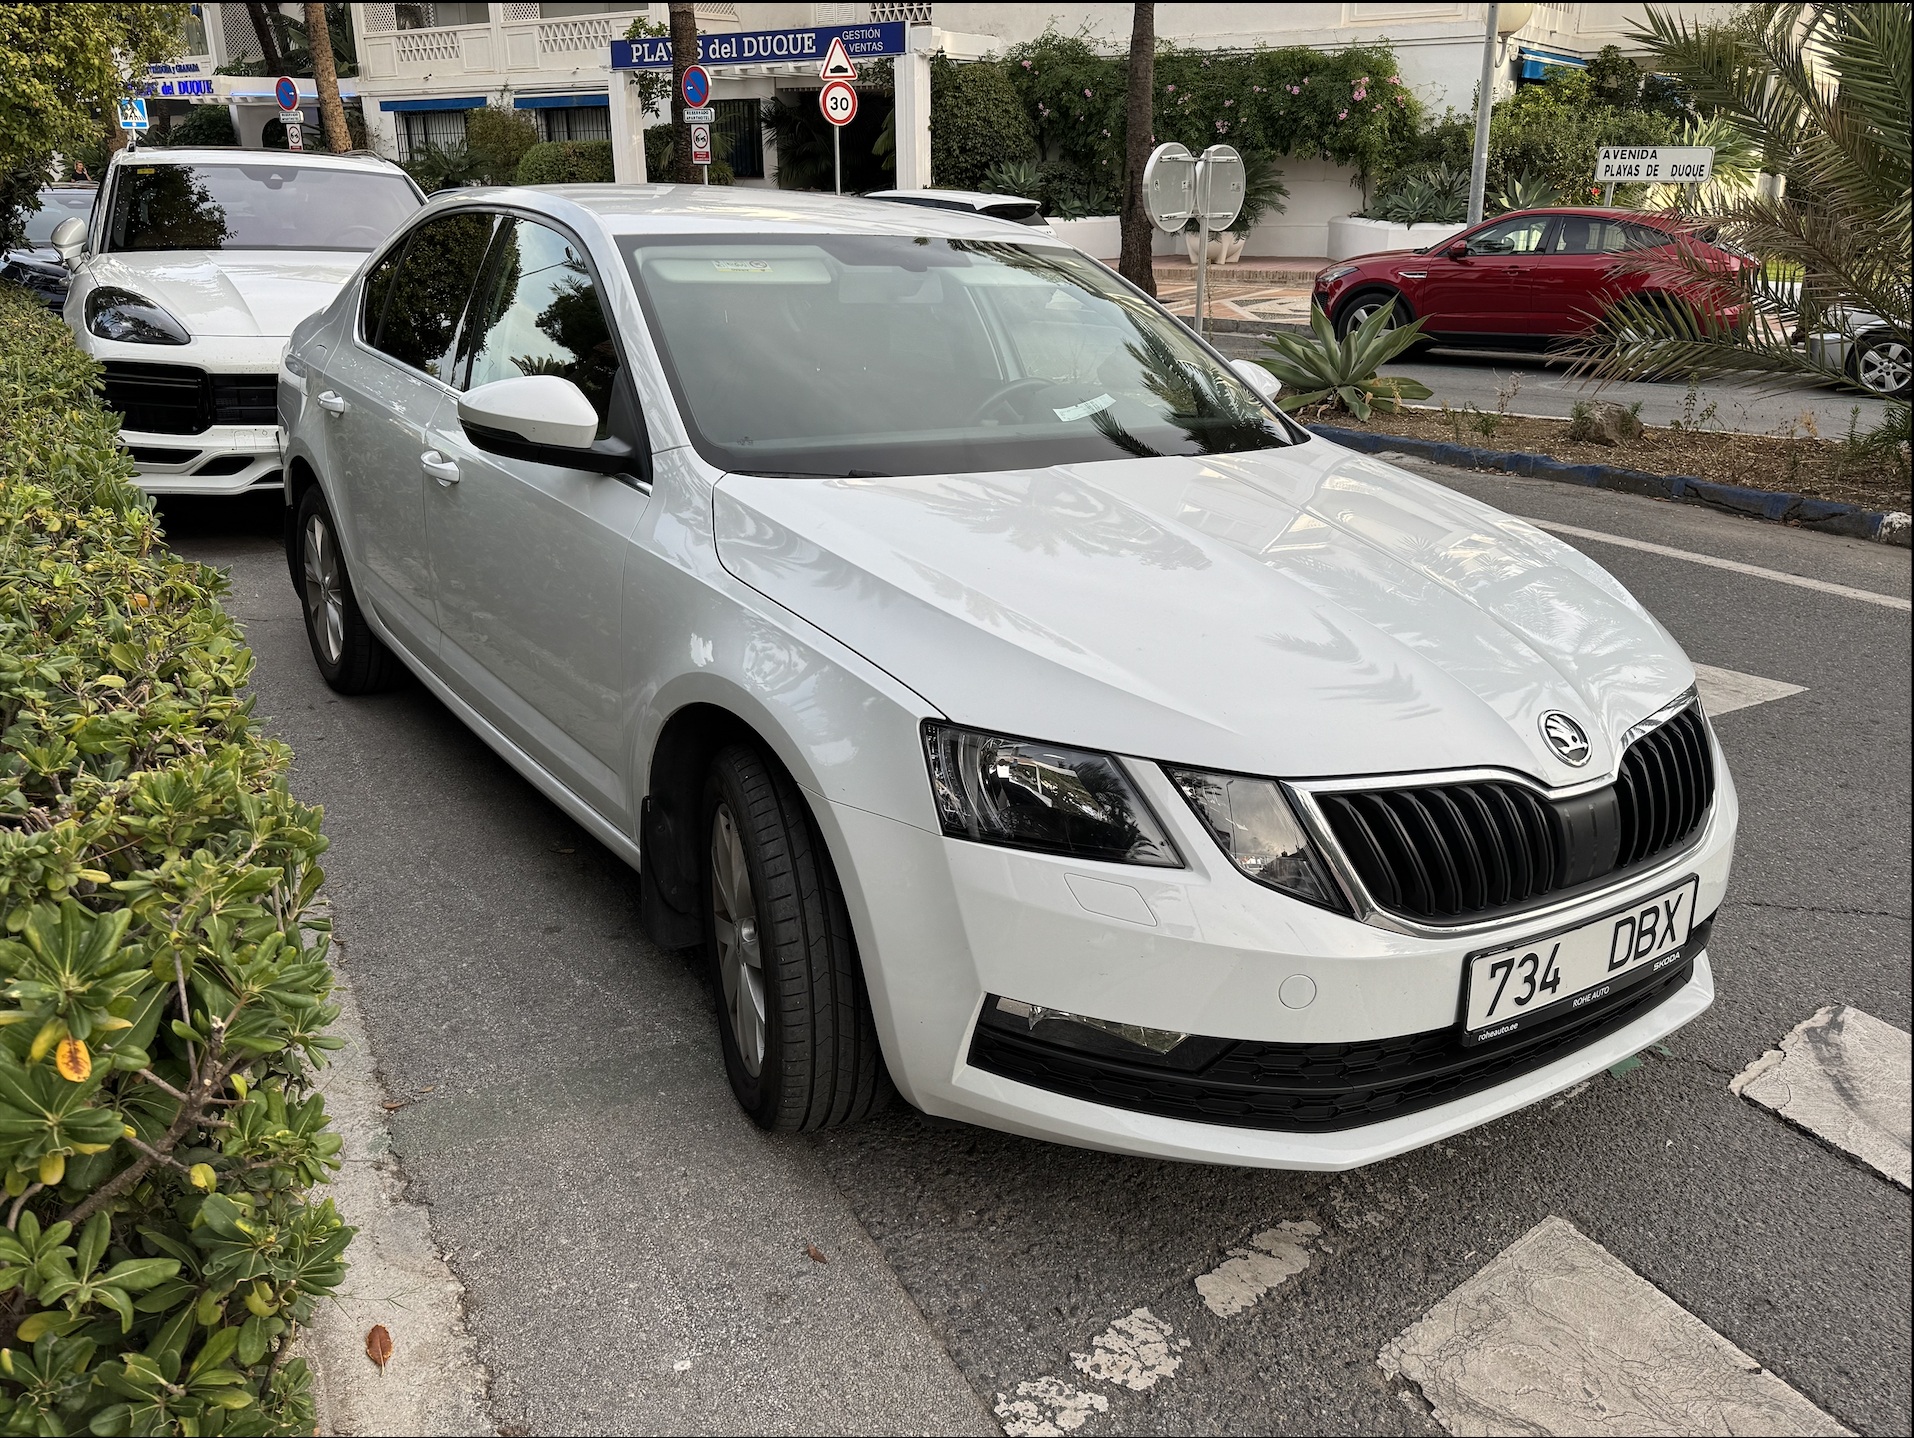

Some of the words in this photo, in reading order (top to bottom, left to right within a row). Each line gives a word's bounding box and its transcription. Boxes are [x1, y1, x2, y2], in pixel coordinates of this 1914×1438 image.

[842, 27, 881, 40] GESTIÓN
[631, 40, 703, 62] PLAS
[709, 38, 737, 59] del
[742, 33, 816, 57] DUQUE
[849, 42, 883, 52] VENTAS
[161, 81, 174, 95] del
[178, 80, 214, 96] DUQUE
[830, 97, 849, 111] 30
[1603, 149, 1658, 160] AVENIDA
[1604, 164, 1640, 177] PLAYAS
[1646, 164, 1659, 176] DE
[1670, 164, 1705, 177] DUQUE
[1486, 942, 1561, 1017] 734
[1608, 893, 1684, 972] DBX
[1572, 993, 1591, 1008] ROHE
[1591, 985, 1610, 1000] AUTO
[1478, 1022, 1519, 1041] roheauto.ee
